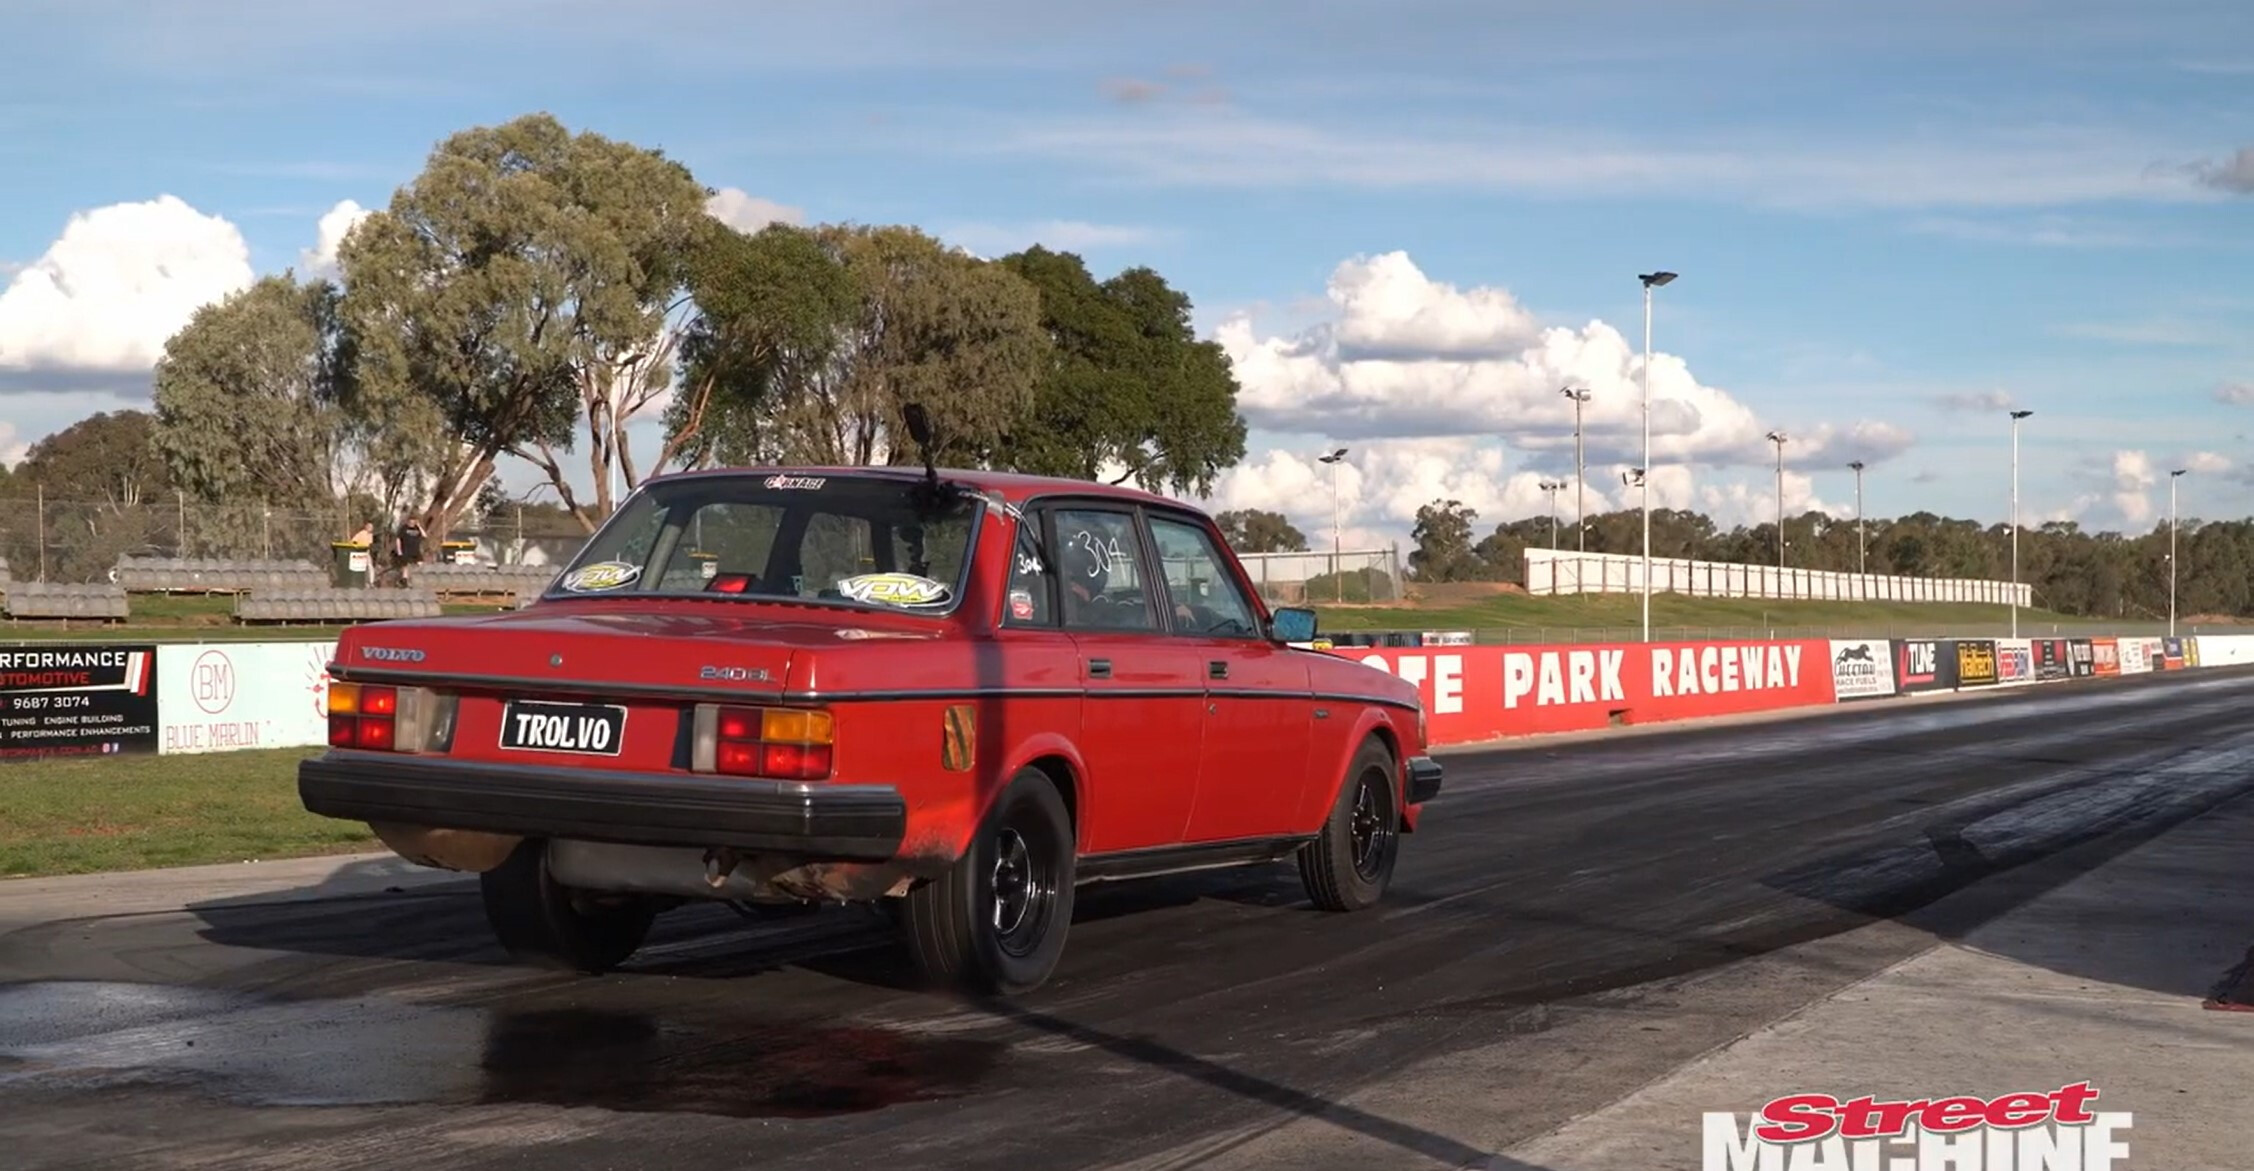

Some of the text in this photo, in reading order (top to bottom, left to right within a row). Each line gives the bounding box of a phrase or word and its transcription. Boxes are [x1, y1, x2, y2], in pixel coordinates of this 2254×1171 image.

[1017, 553, 1042, 576] 304
[1077, 530, 1127, 581] 304
[361, 646, 426, 661] VOLVO
[199, 664, 228, 700] BM
[1360, 645, 1802, 714] TE PARK RACEWAY
[13, 697, 49, 709] 9687
[53, 696, 90, 708] 3074
[2, 714, 124, 726] TUNING ENGINE BUILDING
[11, 726, 150, 739] PERFORMANCE ENHANCEMENTS
[516, 713, 611, 750] TROLVO
[166, 722, 259, 749] BLUE MARLIN
